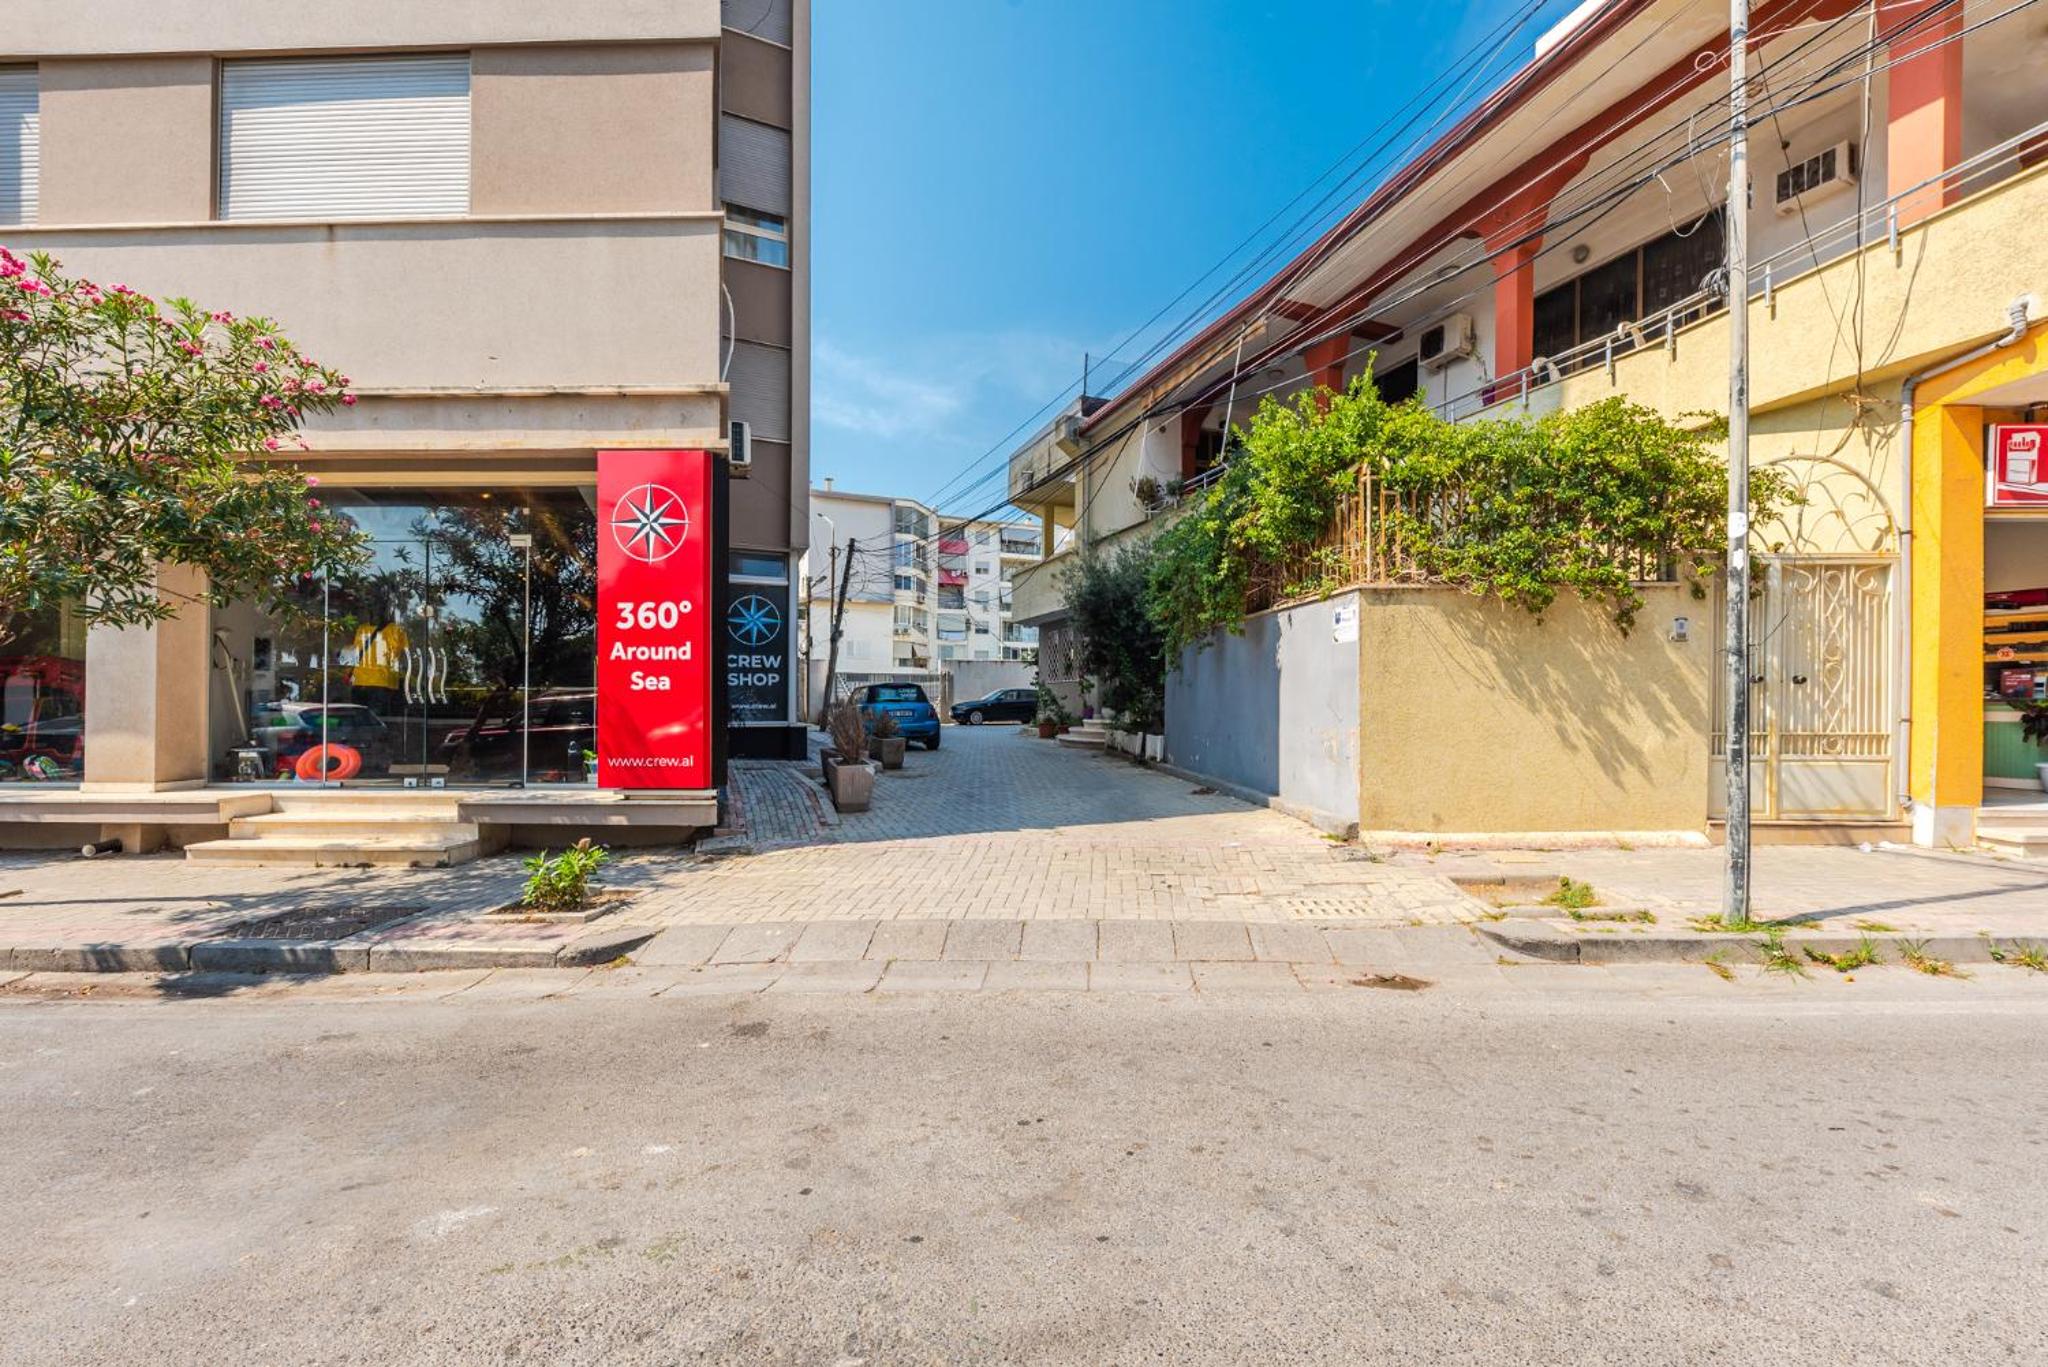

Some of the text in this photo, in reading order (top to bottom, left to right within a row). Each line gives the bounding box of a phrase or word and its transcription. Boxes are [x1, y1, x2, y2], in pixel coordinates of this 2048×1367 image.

[615, 600, 692, 630] 360°
[609, 640, 692, 661] Around
[727, 654, 782, 668] CREW
[630, 670, 671, 691] Sea
[727, 672, 780, 687] SHOP
[608, 754, 694, 768] www.crew.al
